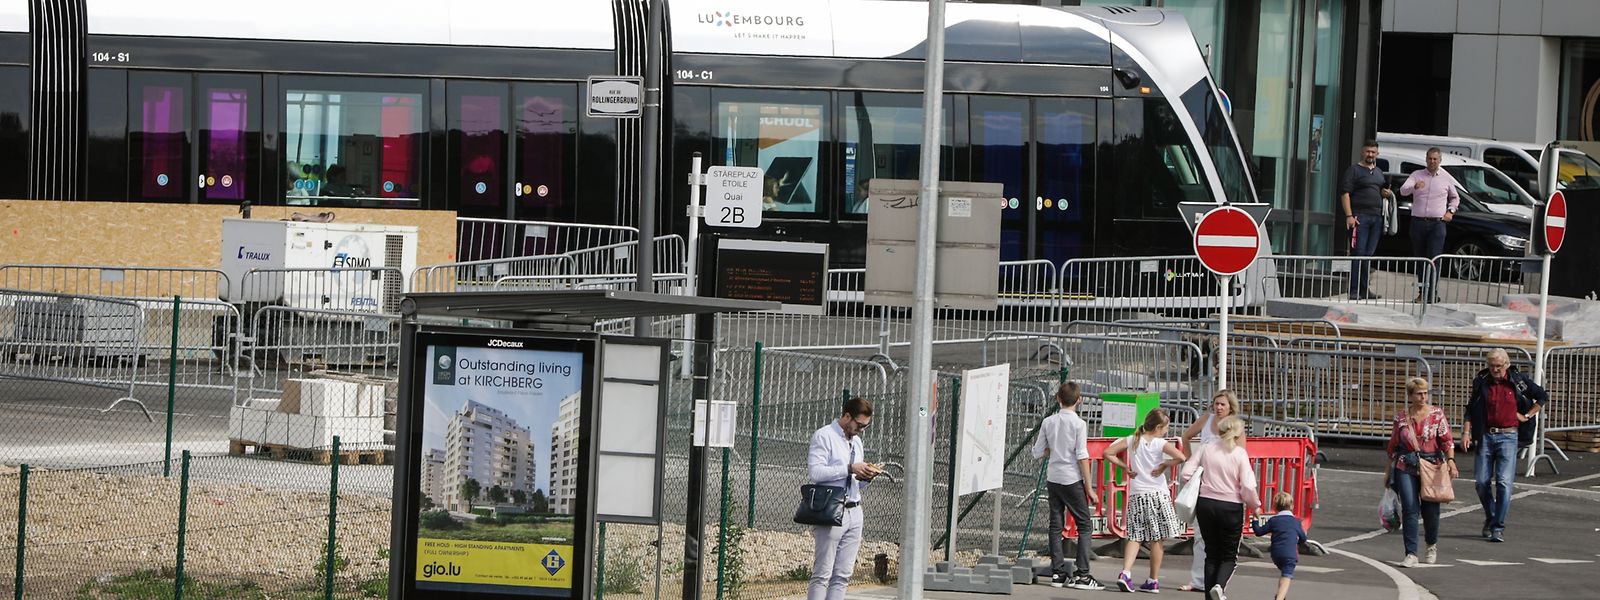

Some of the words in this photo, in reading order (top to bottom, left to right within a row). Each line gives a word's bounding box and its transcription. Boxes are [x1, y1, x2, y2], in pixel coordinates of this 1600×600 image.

[92, 52, 109, 62] 104
[117, 52, 129, 62] S1
[676, 70, 694, 80] 104
[701, 71, 713, 80] C1
[592, 96, 638, 104] ROLLINGERGRUND
[724, 193, 743, 201] Quai
[720, 207, 745, 224] 2B
[351, 297, 378, 306] RENTAL
[487, 339, 523, 348] JCDecaux
[459, 358, 535, 375] Outstanding
[538, 362, 571, 377] living
[459, 376, 471, 386] at
[474, 377, 543, 389] KIRCHBERG
[423, 561, 461, 578] gio.lu
